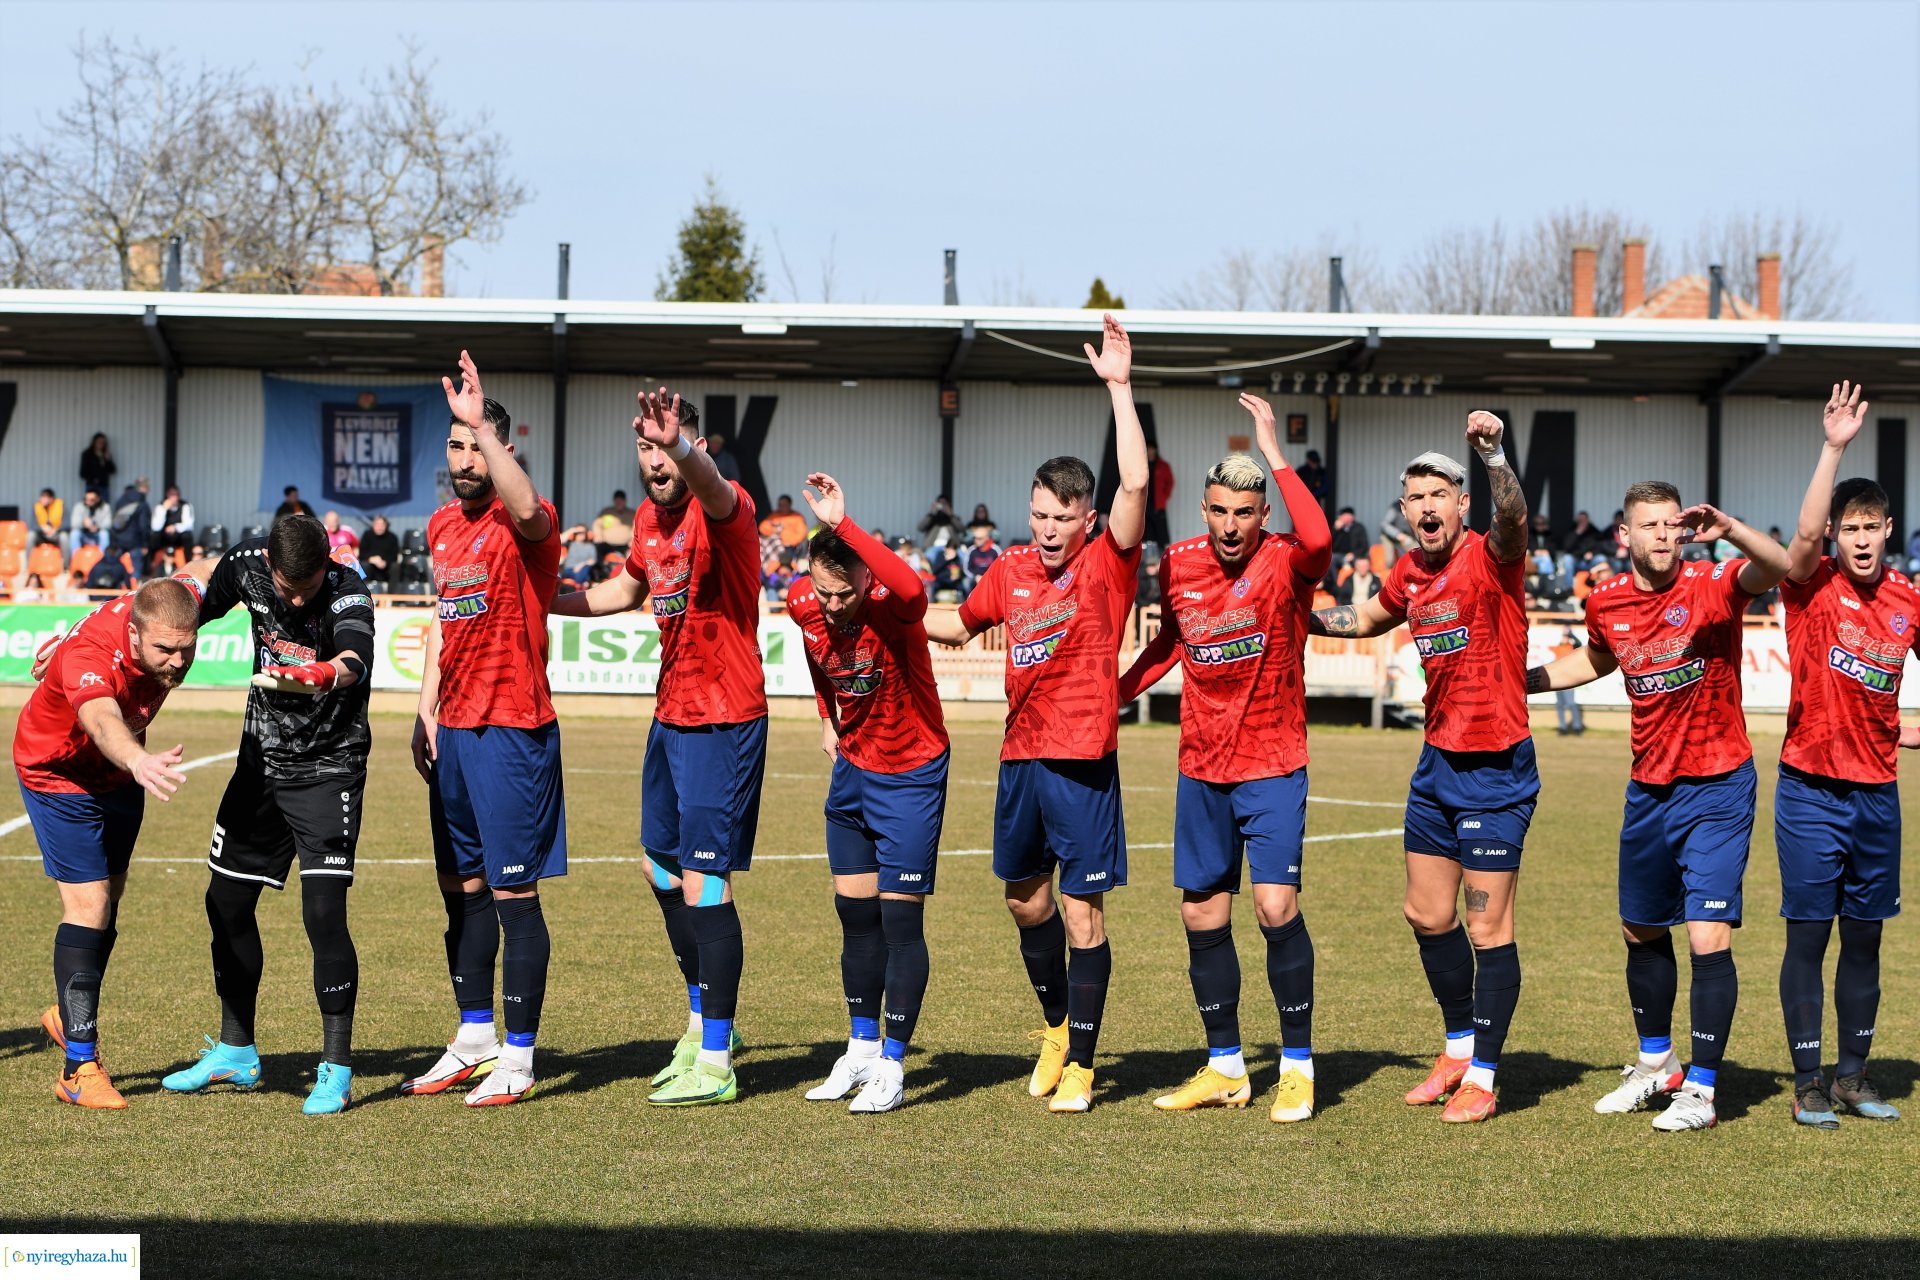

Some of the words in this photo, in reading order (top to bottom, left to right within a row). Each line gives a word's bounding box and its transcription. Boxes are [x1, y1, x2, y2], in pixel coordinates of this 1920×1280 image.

[335, 432, 398, 464] NEM
[1183, 590, 1202, 600] JAKO
[1613, 623, 1630, 632] JAKO
[1462, 821, 1481, 829] JAKO
[694, 850, 715, 859] JAKO
[324, 856, 347, 865] JAKO
[502, 864, 524, 874] JAKO
[900, 873, 921, 881] JAKO
[1085, 871, 1106, 882] JAKO
[1704, 900, 1727, 909] JAKO
[323, 982, 351, 993] JAKO
[502, 995, 522, 1003] AKO
[1200, 1003, 1220, 1012] AKO
[1281, 1003, 1308, 1012] JAKO
[1069, 1020, 1093, 1031] JAKO
[1472, 1016, 1491, 1026] AKO
[1692, 1030, 1715, 1041] JAKO
[1794, 1040, 1820, 1050] JAKO
